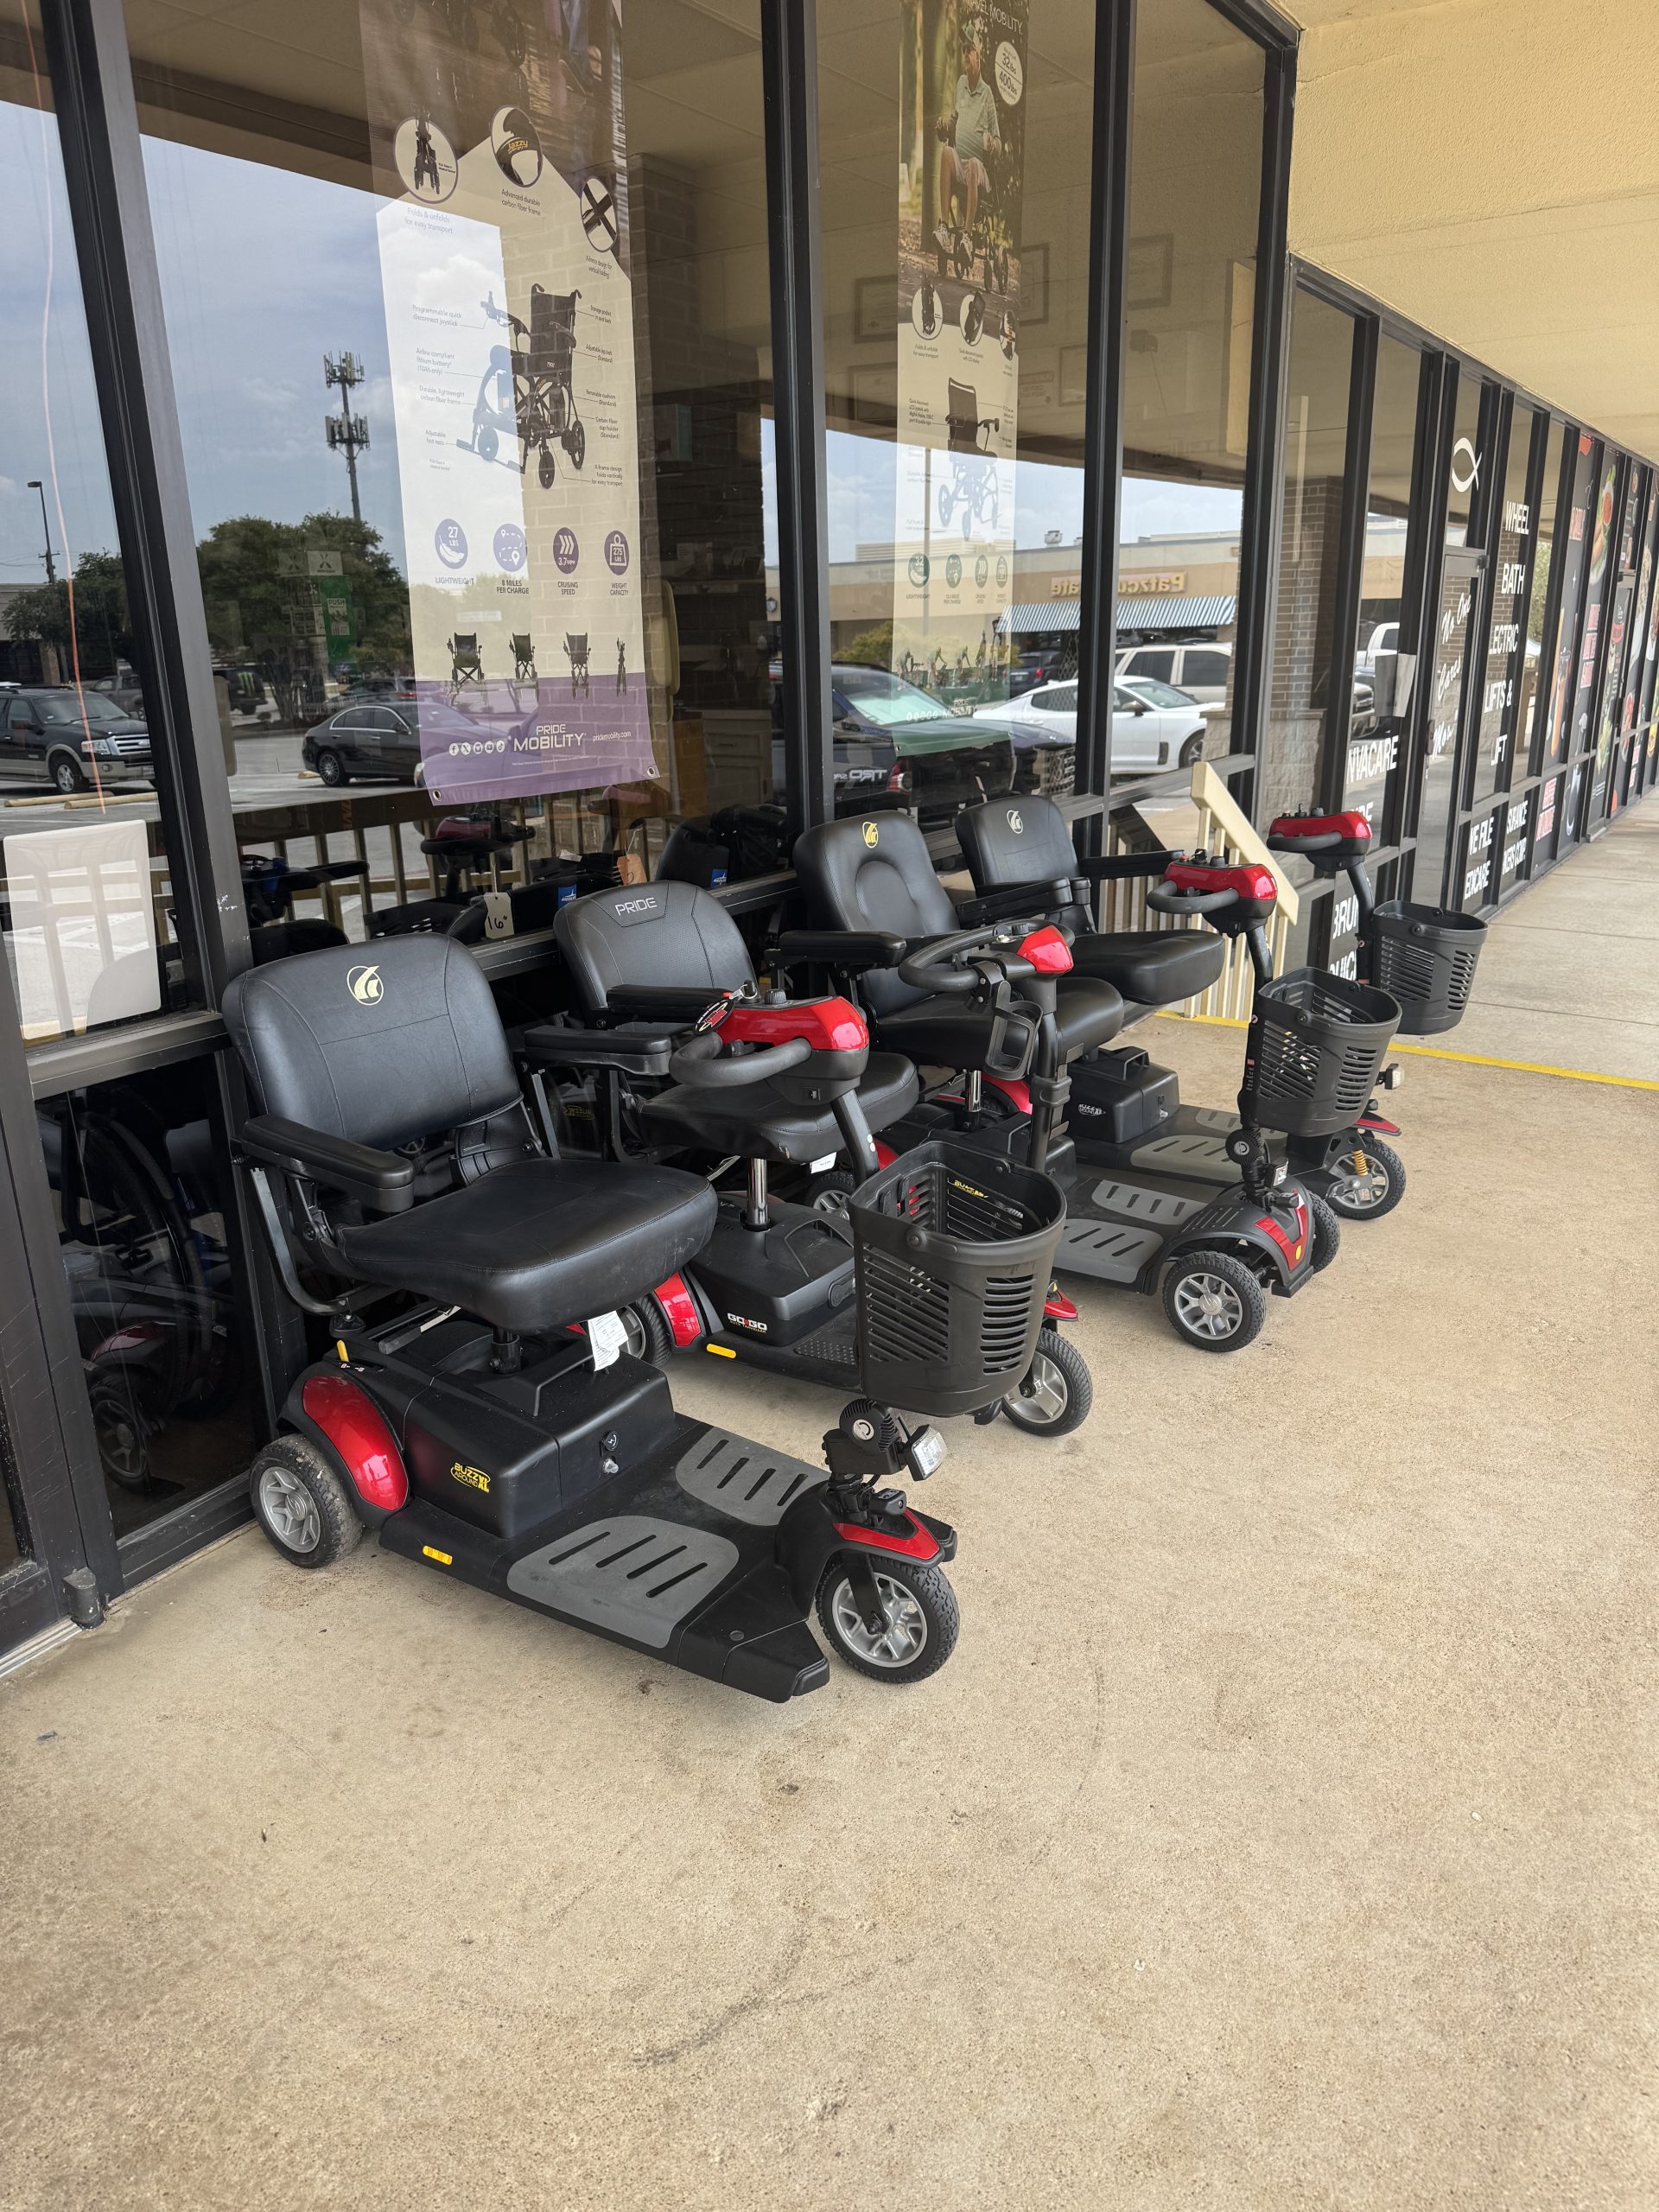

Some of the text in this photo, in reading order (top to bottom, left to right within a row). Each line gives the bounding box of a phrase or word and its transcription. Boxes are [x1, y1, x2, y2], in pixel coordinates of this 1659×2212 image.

[508, 140, 528, 150] Jazzy
[1505, 500, 1529, 535] WHEEL
[448, 526, 459, 538] 27
[613, 547, 623, 556] 275
[915, 556, 925, 566] 32
[435, 576, 474, 586] LIGHTWEIGHT
[1501, 563, 1526, 594] BATH
[1484, 679, 1513, 714] LIFTS &
[536, 724, 566, 735] PRIDE
[513, 731, 632, 752] MOBILITY pridemobility.com
[1347, 734, 1399, 785] NVACARE
[1506, 800, 1528, 835] SURANCE
[1478, 817, 1494, 850] FILE
[1464, 860, 1491, 900] EDICARE
[615, 898, 657, 916] PRIDE
[1332, 894, 1359, 939] BRUN
[454, 1462, 479, 1481] BUZZ
[454, 1471, 489, 1493] AROUND XL
